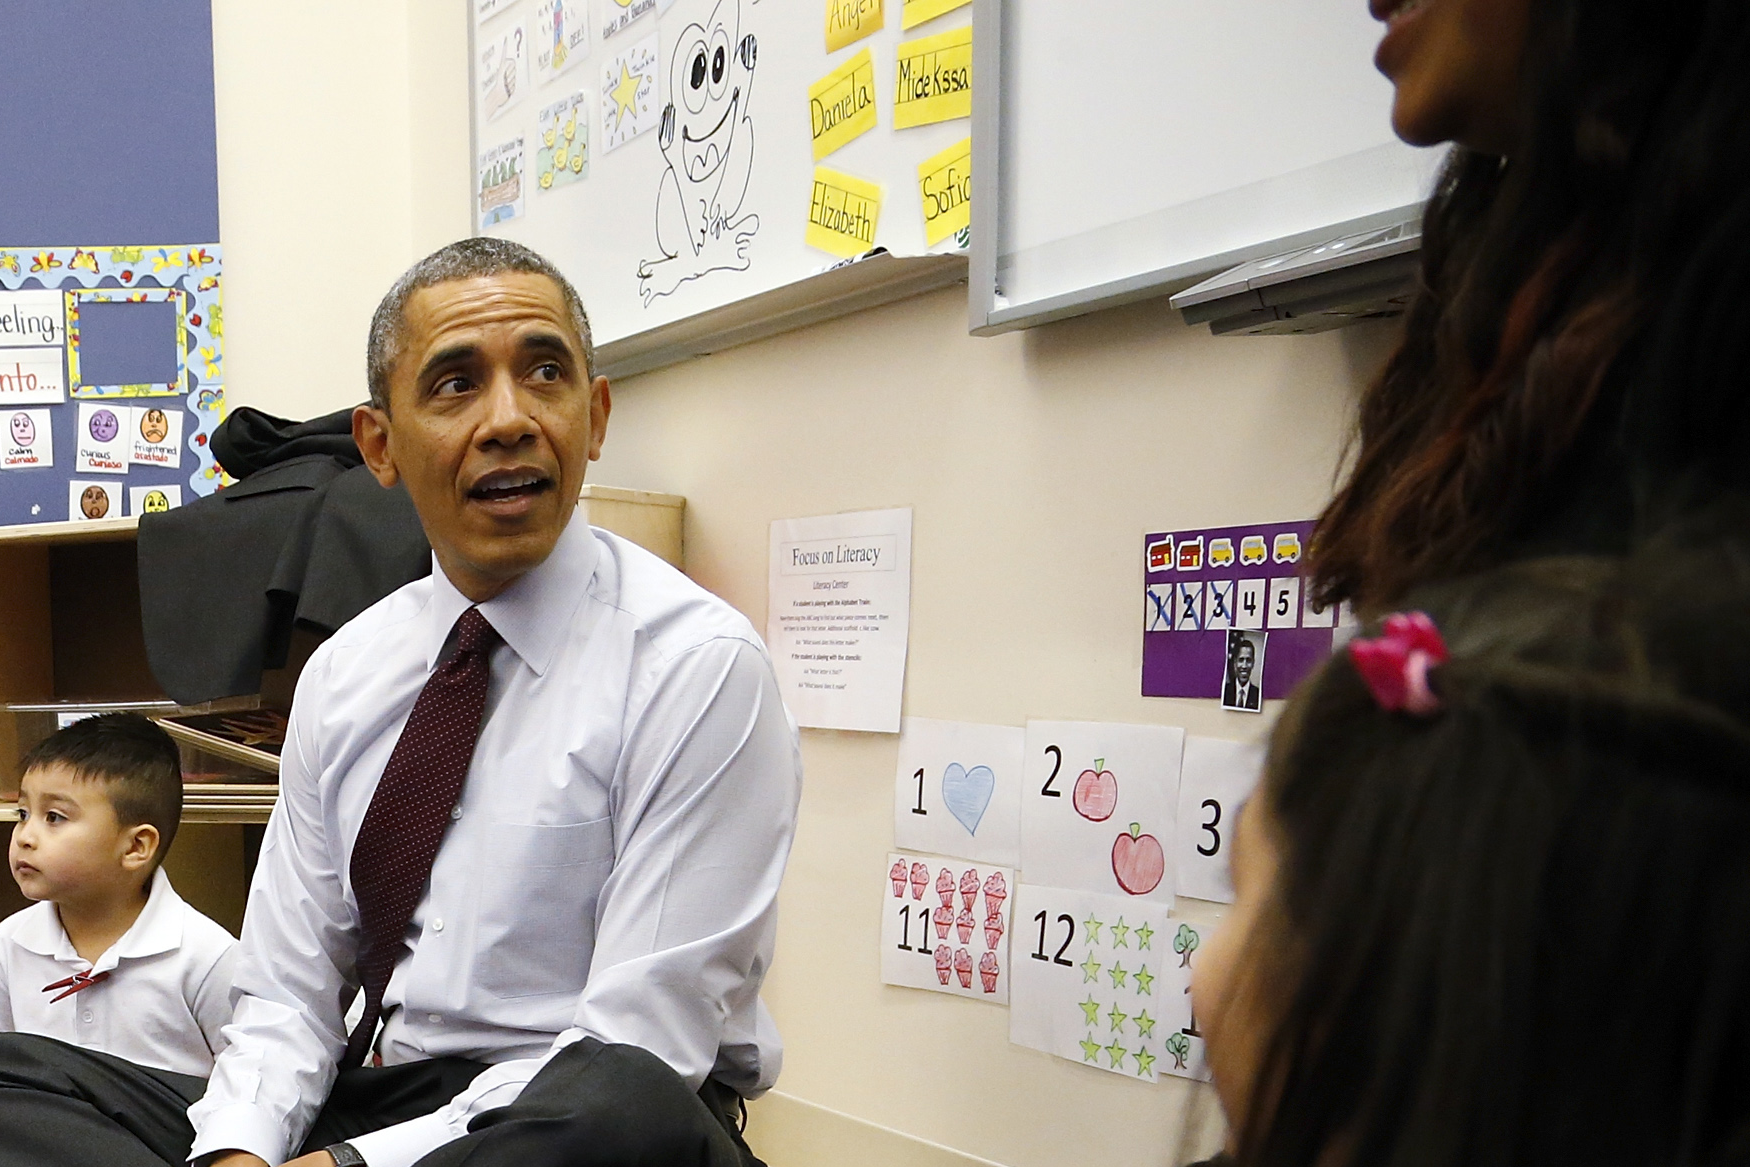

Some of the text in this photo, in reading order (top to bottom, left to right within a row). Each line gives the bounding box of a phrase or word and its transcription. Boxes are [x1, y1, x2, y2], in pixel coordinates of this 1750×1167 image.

[830, 0, 874, 34] Ange
[810, 72, 871, 139] Daniela
[811, 182, 871, 243] Elizabeth
[5, 456, 39, 464] calmado
[81, 449, 111, 459] curious
[134, 441, 177, 455] frightened
[792, 545, 881, 566] Focus on Literacy
[1155, 595, 1163, 620] 1
[1182, 594, 1194, 619] 2
[1213, 593, 1224, 618] 3
[1243, 591, 1256, 616] 4
[1276, 590, 1290, 616] 5
[1041, 744, 1063, 798] 2
[911, 767, 928, 816] 1
[1196, 798, 1222, 857] 3
[897, 904, 934, 956] 11
[1031, 909, 1076, 968] 12
